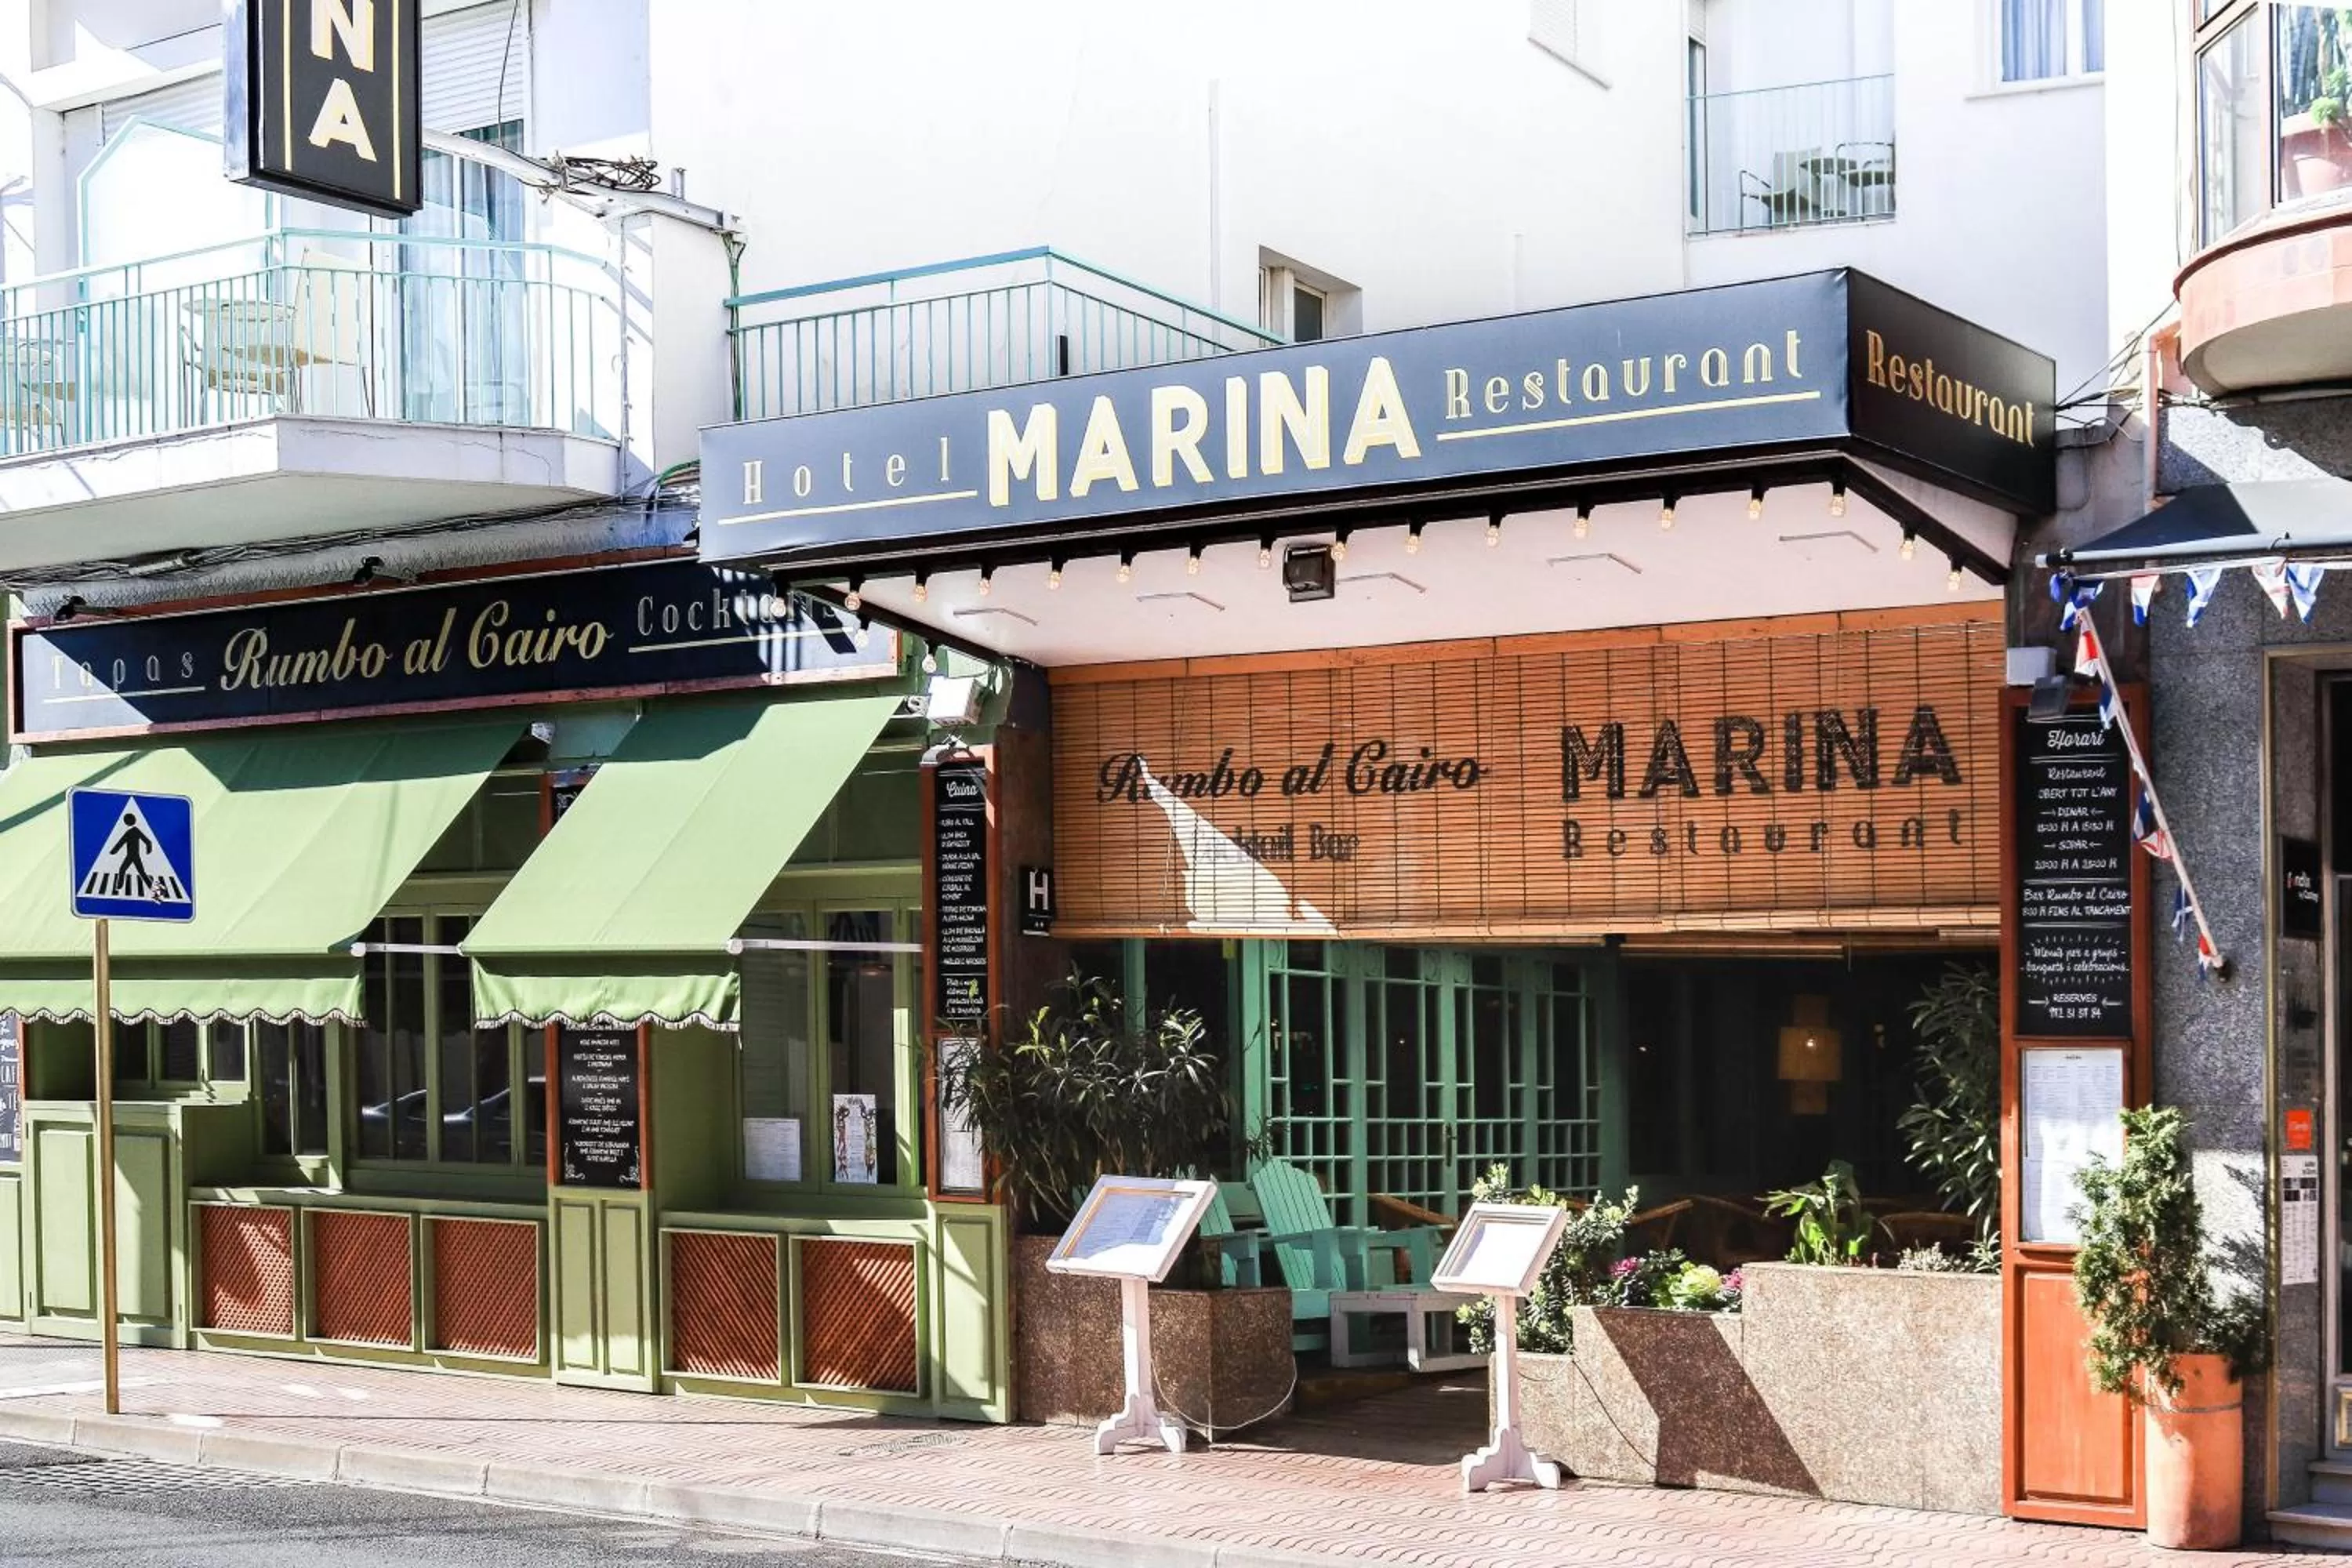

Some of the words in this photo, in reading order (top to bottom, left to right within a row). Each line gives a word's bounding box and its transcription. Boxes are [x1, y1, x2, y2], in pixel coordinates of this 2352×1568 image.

[1865, 328, 2036, 448] Restaurant
[742, 436, 950, 505] Hotel
[987, 355, 1421, 507] MARINA
[1445, 328, 1802, 420] Restaurant
[51, 651, 194, 690] Tapas
[220, 616, 392, 691] Rumbo
[404, 608, 457, 677] al
[468, 598, 615, 669] Cairo
[1561, 705, 1963, 802] MARINA
[2047, 729, 2105, 750] Horari
[1281, 742, 1335, 797] al
[1345, 739, 1490, 797] Cairo
[2047, 767, 2107, 780] Restaurant
[2038, 788, 2068, 799] OBERT
[2071, 788, 2089, 797] TOT
[2057, 807, 2089, 817] DINAR
[1309, 822, 1360, 861] Bar
[1561, 808, 1962, 859] Restaurant
[1029, 870, 1048, 909] H
[2024, 888, 2045, 902] Bar
[2046, 887, 2084, 901] Rumbo
[2085, 887, 2097, 900] al
[2099, 887, 2129, 901] Cairo
[2047, 906, 2069, 916] FINS
[2071, 905, 2082, 916] AL
[2084, 904, 2132, 916] TANCAMENT
[2053, 993, 2098, 1003] RESERVES
